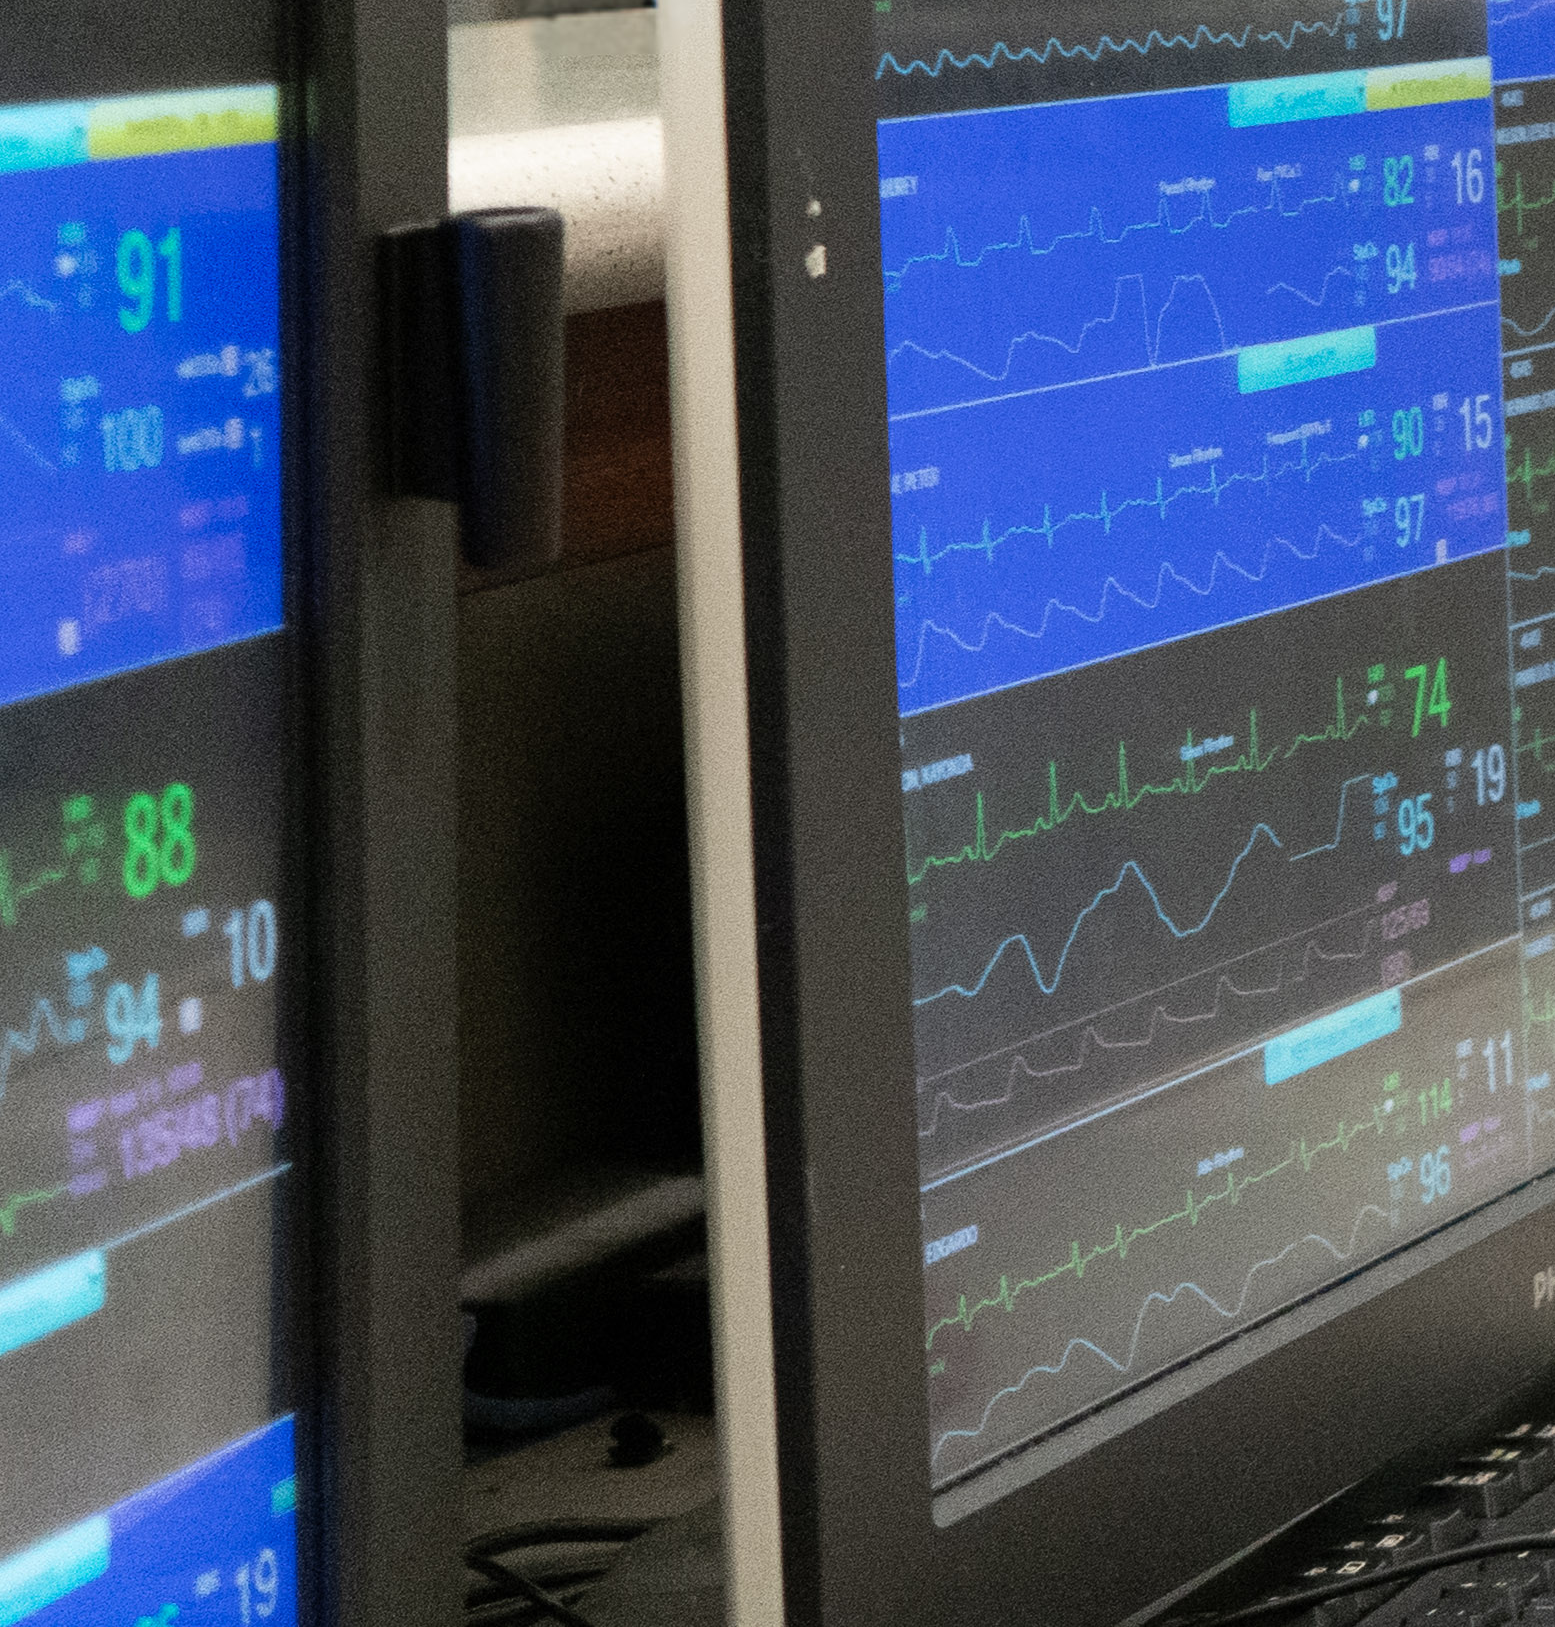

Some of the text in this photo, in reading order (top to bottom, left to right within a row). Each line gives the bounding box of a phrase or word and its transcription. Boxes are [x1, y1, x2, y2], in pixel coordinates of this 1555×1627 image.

[1383, 148, 1485, 207] 82 16
[114, 227, 183, 333] 91
[1385, 242, 1418, 295] 94
[1391, 406, 1424, 461] 90
[1459, 394, 1493, 452] 15
[1394, 492, 1426, 548] 97
[1404, 657, 1453, 739] 74
[1471, 742, 1507, 807] 19
[121, 781, 197, 900] 88
[1399, 791, 1435, 856] 95
[224, 898, 278, 989] 10
[104, 972, 162, 1066] 94
[1483, 1029, 1513, 1094] 11
[1419, 1142, 1452, 1206] 96
[235, 1546, 279, 1627] 19
